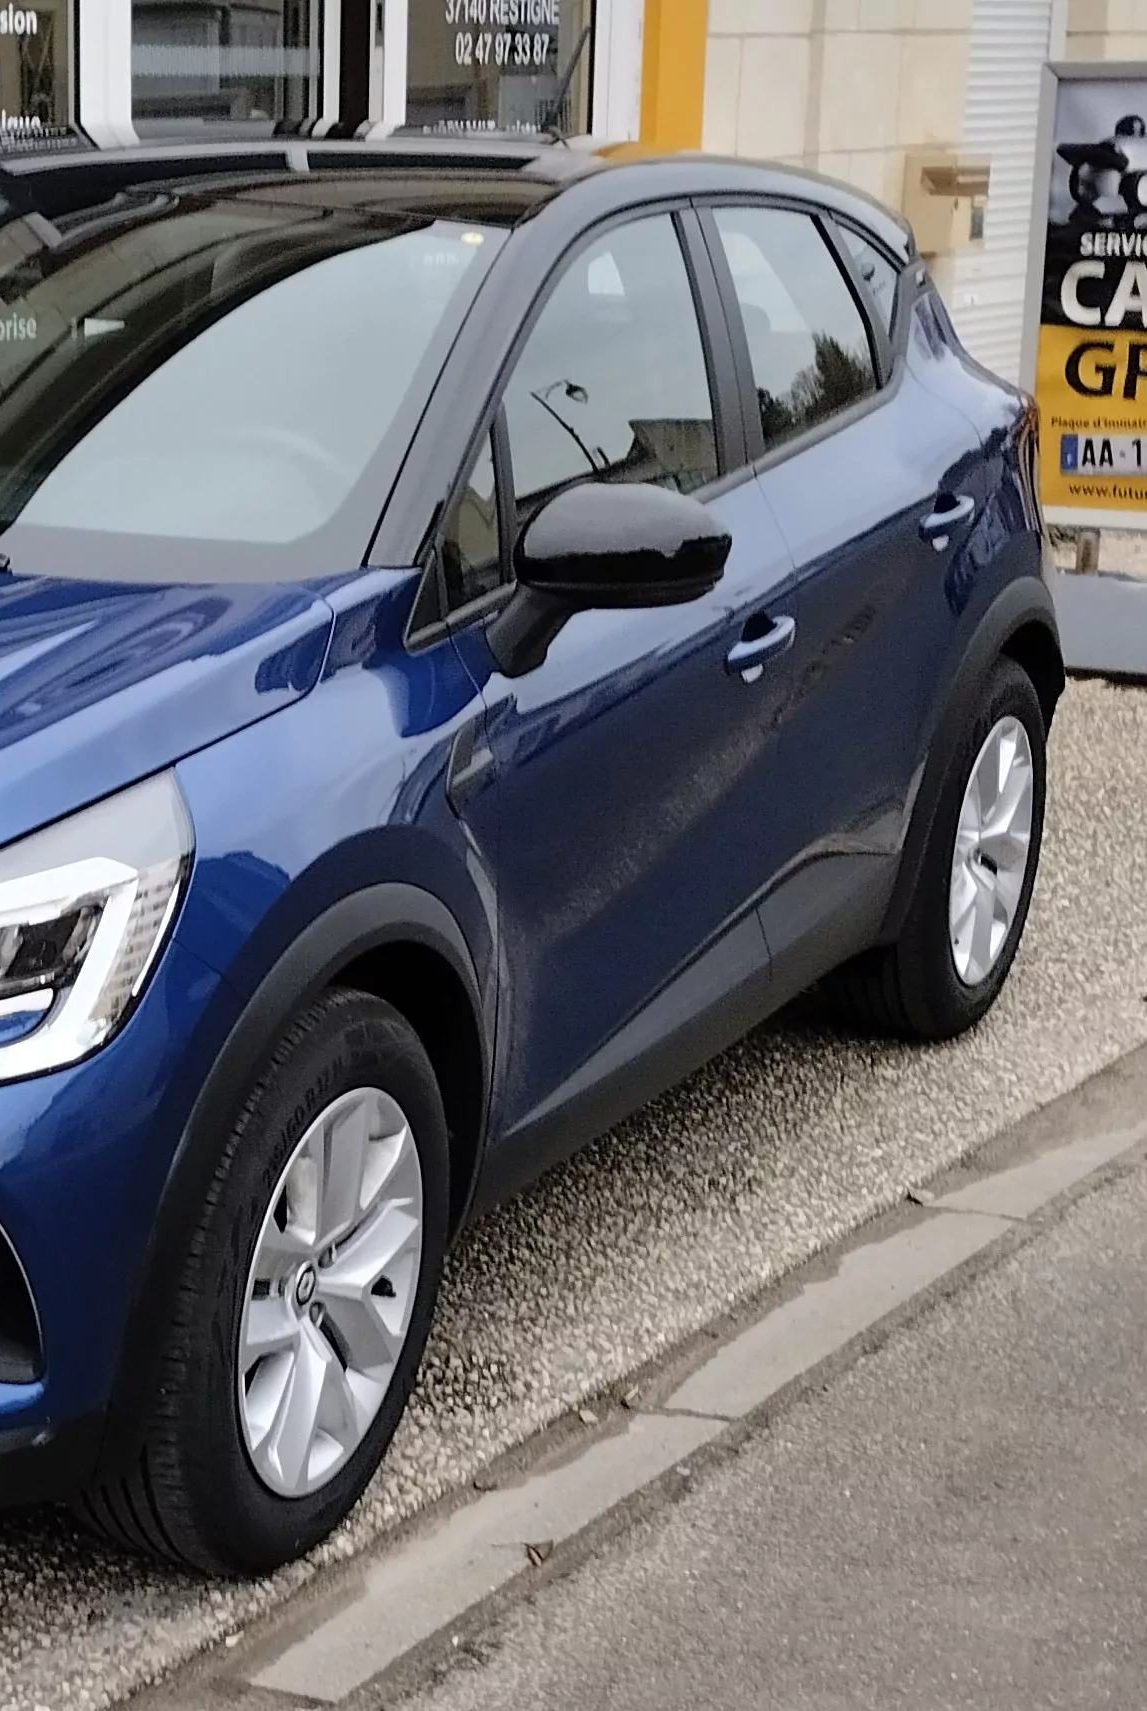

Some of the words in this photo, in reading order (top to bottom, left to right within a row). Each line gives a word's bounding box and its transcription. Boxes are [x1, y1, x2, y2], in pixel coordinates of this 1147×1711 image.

[455, 32, 473, 66] 02
[475, 32, 493, 66] 47
[495, 32, 512, 66] 97
[514, 32, 531, 66] 33
[533, 32, 550, 66] 87
